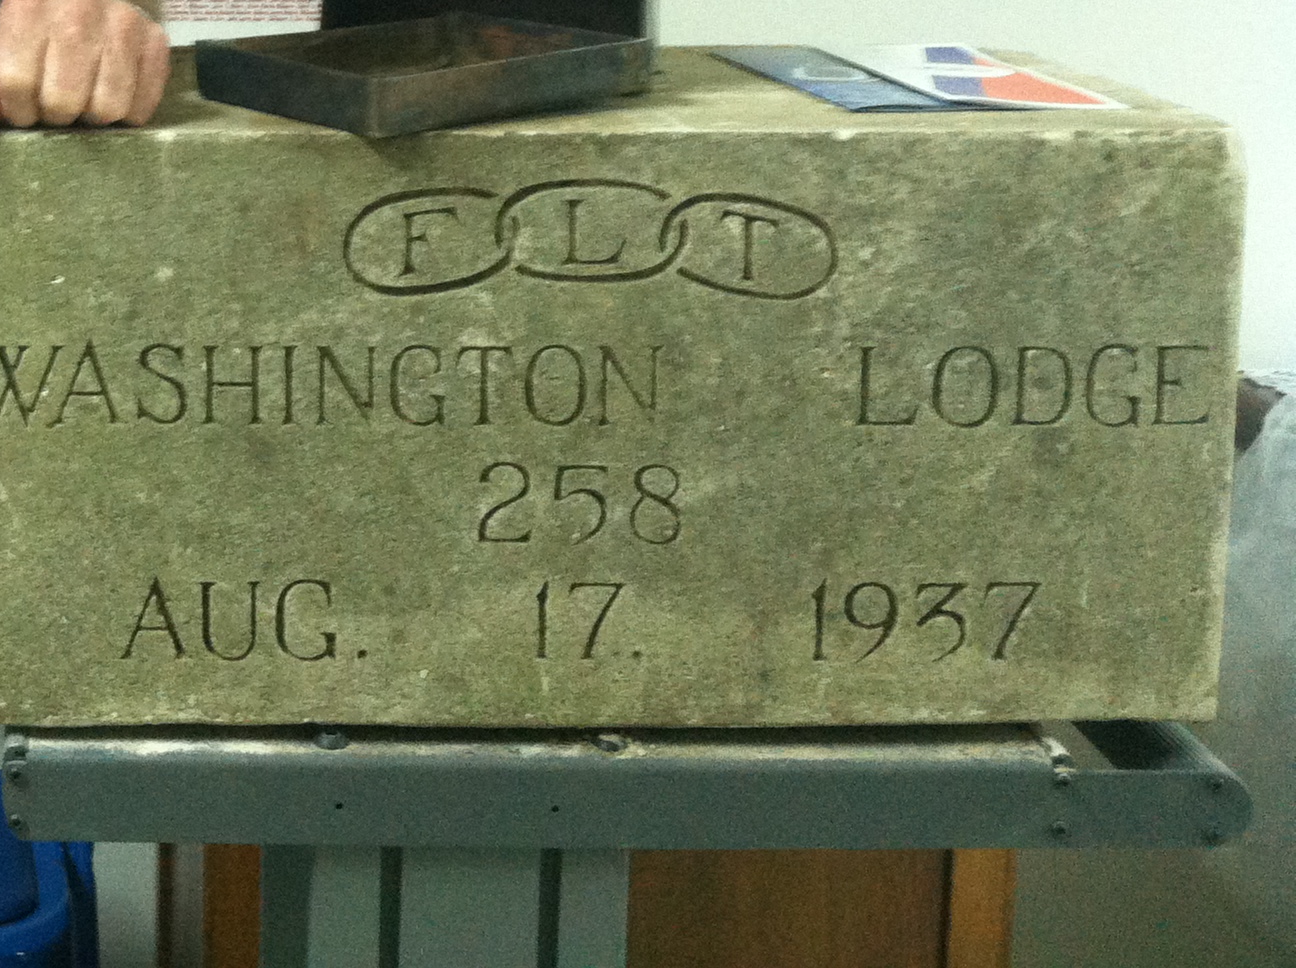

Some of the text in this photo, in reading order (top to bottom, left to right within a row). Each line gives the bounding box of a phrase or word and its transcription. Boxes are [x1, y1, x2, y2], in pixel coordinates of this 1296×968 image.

[400, 197, 780, 280] F L T
[854, 342, 1211, 429] LODGE
[477, 460, 682, 546] 258
[119, 575, 369, 662] AUG.
[810, 576, 1045, 664] 1937
